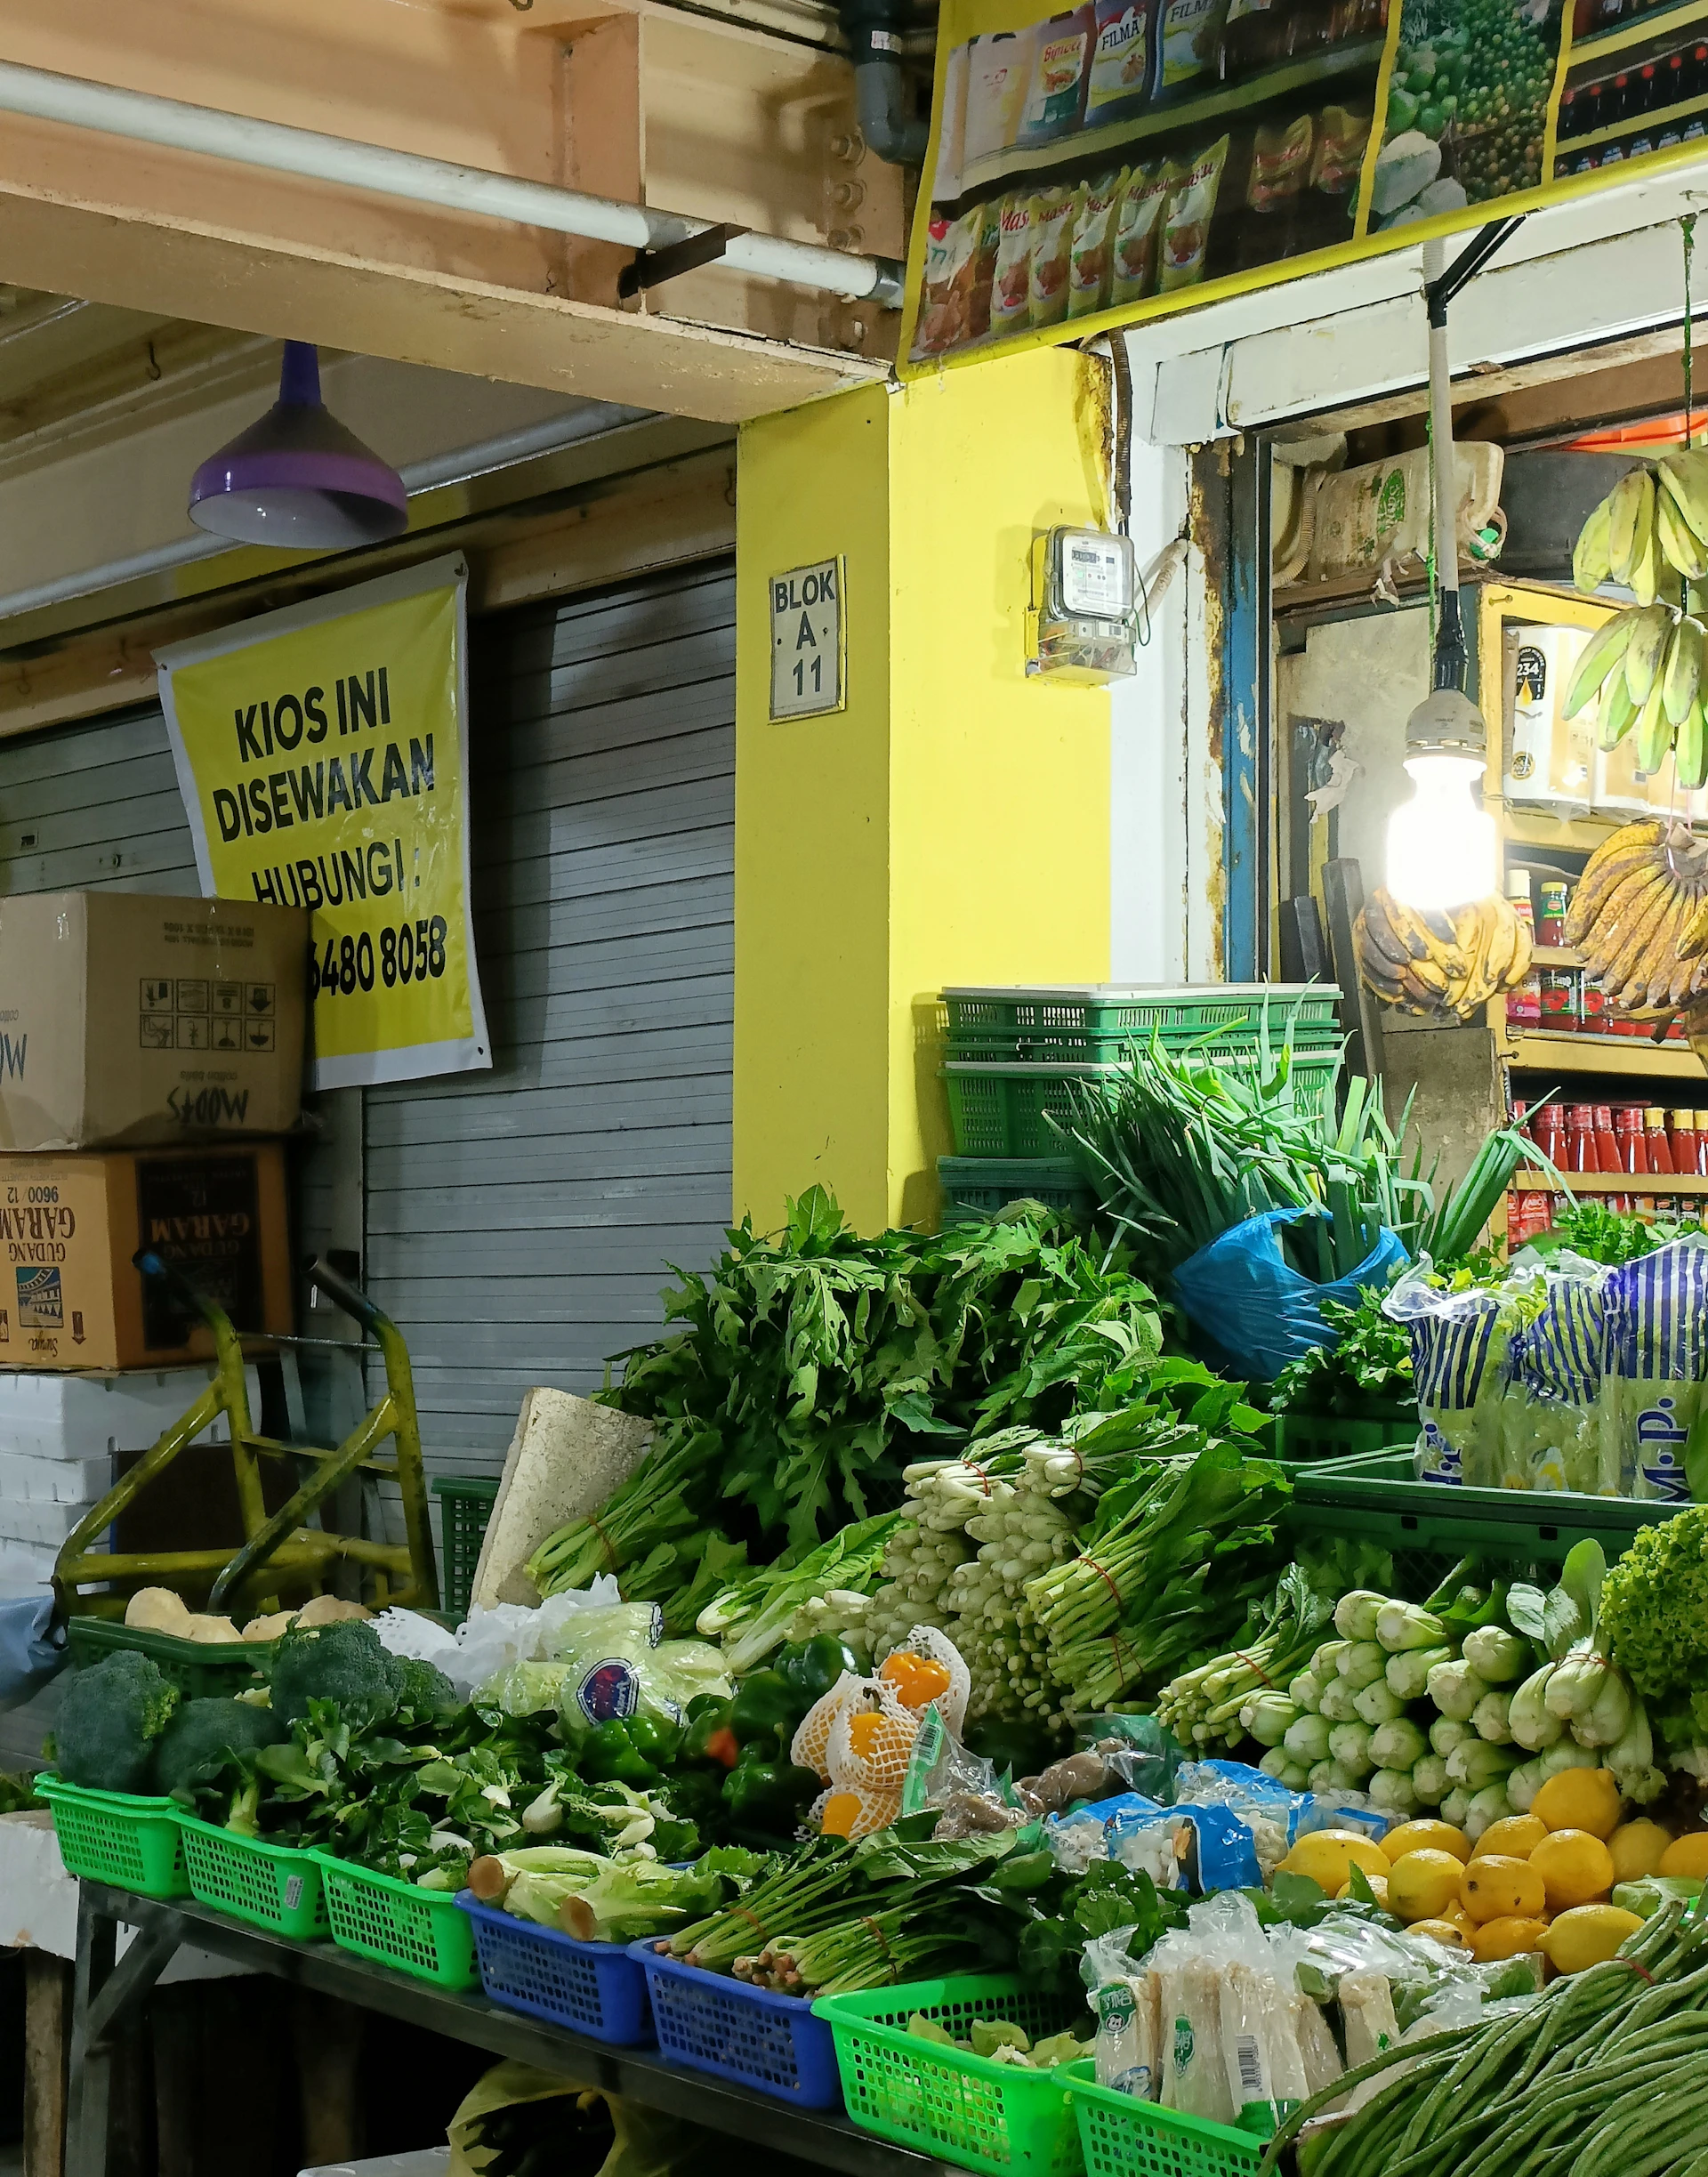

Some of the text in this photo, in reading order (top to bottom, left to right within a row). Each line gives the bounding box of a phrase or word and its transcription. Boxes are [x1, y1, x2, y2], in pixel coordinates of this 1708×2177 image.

[1101, 19, 1140, 51] FILMA
[775, 570, 835, 614] BLOK
[795, 610, 817, 650] A
[792, 655, 822, 696] 11
[234, 666, 391, 762] KIOS INI
[212, 733, 435, 843] DISEWAKAN
[251, 838, 404, 912] HUBUNGI
[380, 915, 447, 989] 8058
[0, 1206, 76, 1239] GARAM
[149, 1212, 250, 1243] GARAM
[8, 1242, 66, 1262] GUDANG
[163, 1238, 240, 1259] GUDANG
[28, 1332, 59, 1359] Surya
